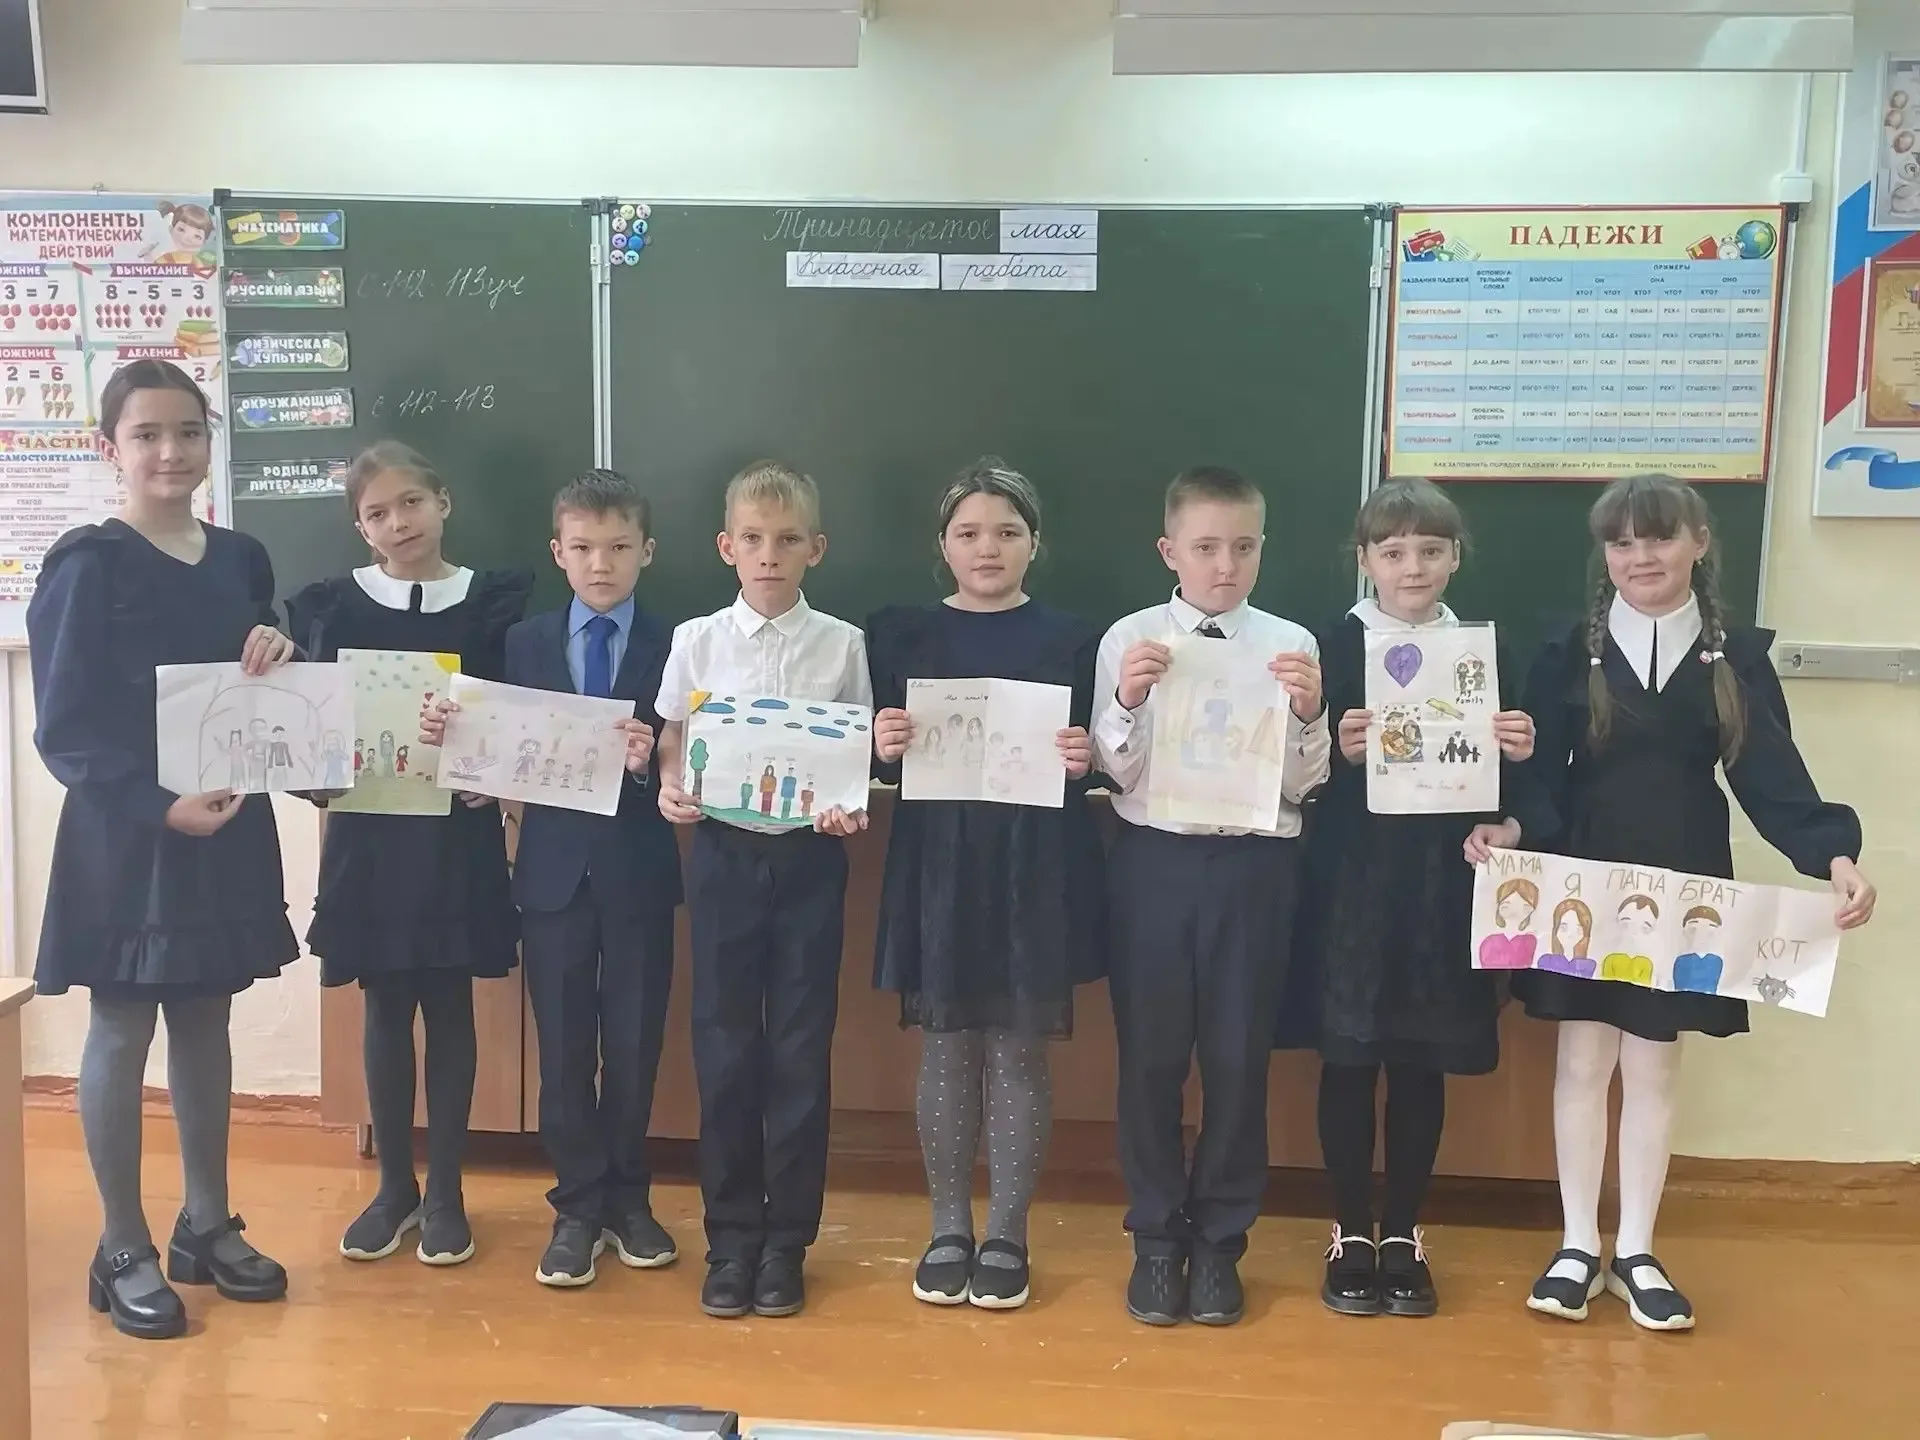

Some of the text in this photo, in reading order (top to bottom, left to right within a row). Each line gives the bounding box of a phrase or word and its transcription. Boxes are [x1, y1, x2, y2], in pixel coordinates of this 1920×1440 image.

[7, 213, 145, 228] КОМПОНЕНТЫ
[237, 222, 329, 233] МАТЕМАТИКА
[763, 208, 1087, 252] Тринадцатое мая
[10, 229, 143, 241] МАТЕМАТИЧЕСКИХ
[1509, 224, 1663, 249] ПАДЕЖИ
[39, 244, 114, 260] ДЕЙСТВИЙ
[116, 266, 188, 275] ВЫЧИТАНИЕ
[957, 254, 1069, 290] работа
[1438, 275, 1469, 284] ПАДЕЖЕЙ
[5, 284, 16, 300] 3
[48, 284, 59, 300] 7
[106, 284, 118, 300] 8
[148, 284, 160, 300] 5
[193, 284, 204, 300] 3
[230, 283, 337, 296] РУССКИЙ ЯЗЫК
[244, 338, 331, 349] ФИЗИЧЕСКАЯ
[128, 348, 180, 357] ДЕЛЕНИЕ
[254, 352, 323, 364] КУЛЬТУРА
[7, 366, 19, 381] 2
[51, 365, 64, 381] 6
[194, 366, 205, 381] 2
[241, 392, 343, 409] ОКРУЖАЮЩИЙ
[279, 411, 308, 422] МИР
[17, 437, 91, 449] ЧАСТИ
[263, 465, 318, 477] РОДНАЯ
[250, 478, 335, 491] ЛИТЕРАТУРА
[0, 577, 34, 585] ПРЕДЛО
[1485, 853, 1743, 909] МАМА Я ПАПА БРАТ
[1756, 938, 1808, 965] КОТ
